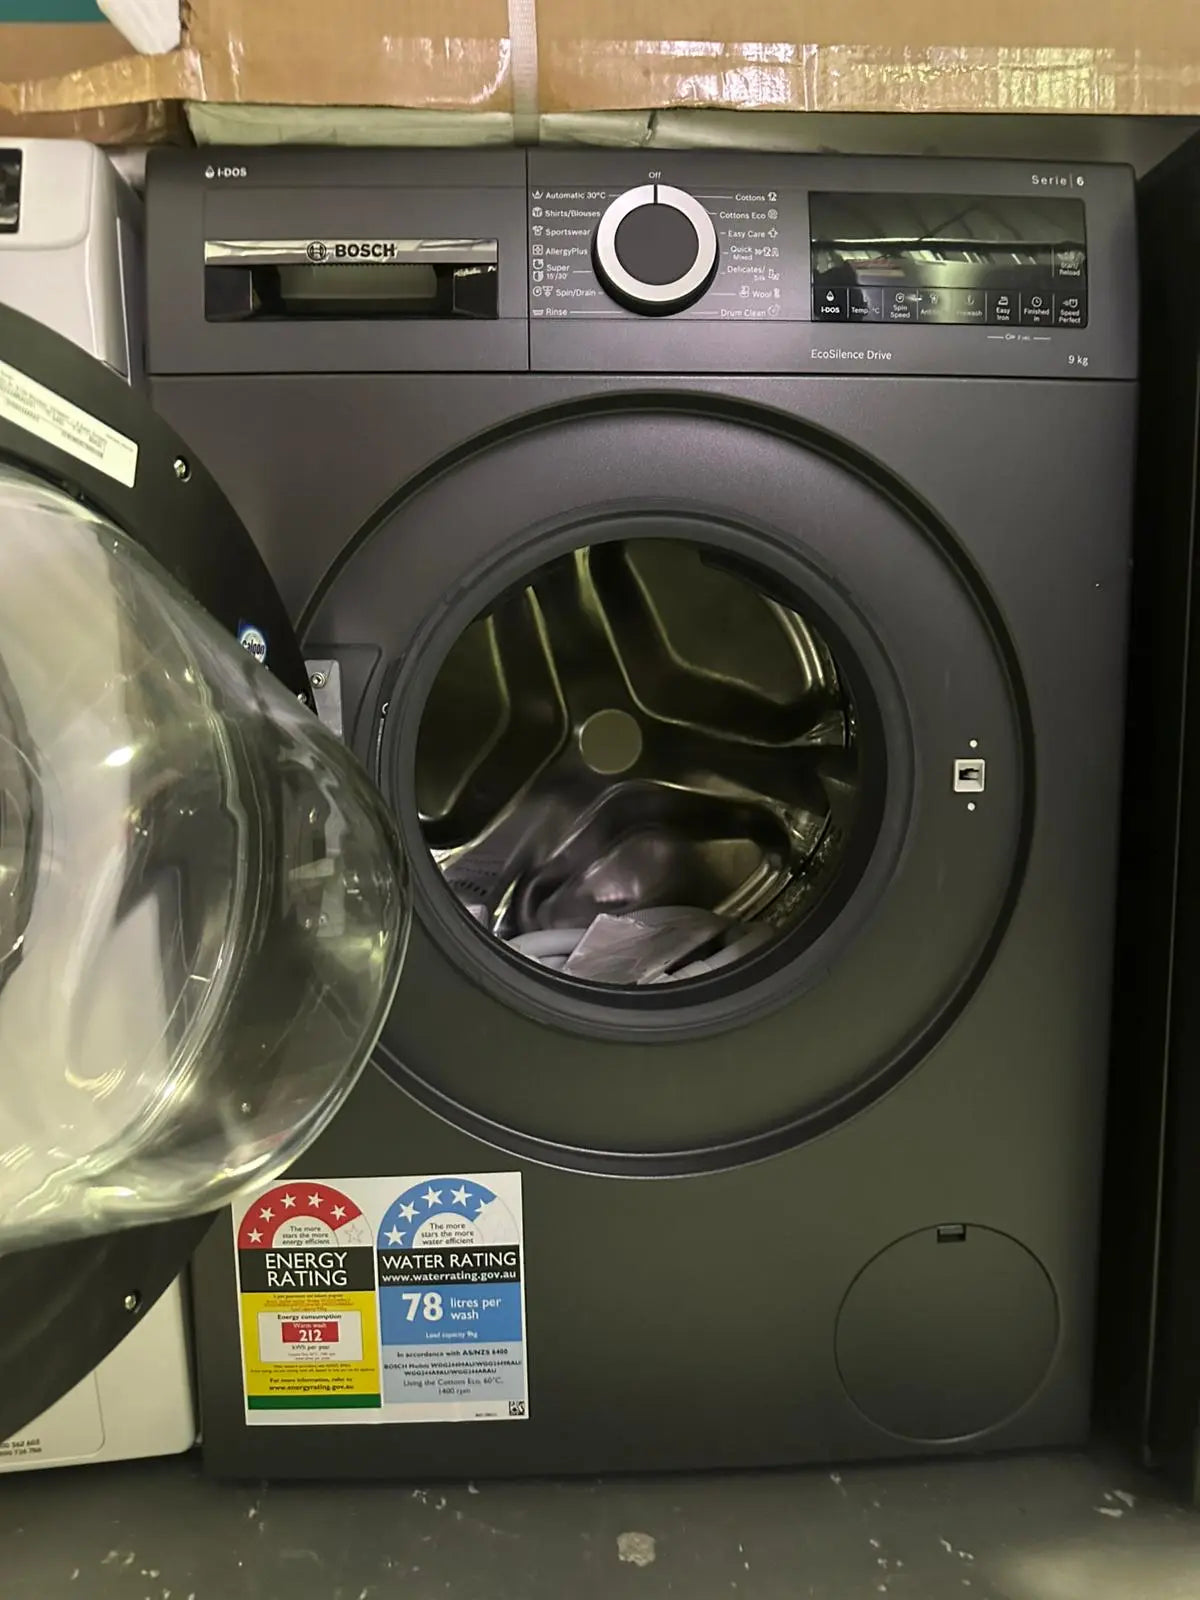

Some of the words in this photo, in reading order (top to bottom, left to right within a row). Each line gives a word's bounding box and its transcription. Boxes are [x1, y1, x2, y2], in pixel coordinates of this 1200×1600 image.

[648, 171, 661, 179] Off
[1031, 174, 1067, 186] Serie
[1076, 176, 1084, 186] 6
[545, 191, 585, 199] Automatic
[735, 193, 765, 201] Cottons
[544, 209, 601, 218] Shirts/Blouses
[719, 211, 750, 220] Cottons
[751, 212, 766, 220] Eco
[545, 228, 591, 237] Sportswear
[728, 229, 745, 239] Easy
[747, 230, 765, 238] Care
[335, 243, 396, 258] BOSCH
[545, 247, 588, 257] AllergyPlus
[730, 245, 752, 253] Quick
[546, 264, 570, 272] Super
[555, 288, 596, 297] Spin/Drain
[752, 290, 772, 298] Wool
[546, 308, 568, 316] Rinse
[892, 304, 908, 312] Spin
[996, 307, 1011, 315] Easy
[1023, 308, 1050, 316] Finished
[720, 309, 743, 317] Drum
[744, 309, 766, 317] Clean
[890, 311, 911, 319] Speed
[1060, 309, 1080, 317] Speed
[1058, 316, 1081, 324] Perfect
[811, 349, 865, 360] EcoSilence
[867, 350, 892, 360] Drive
[1068, 354, 1075, 364] 9
[1077, 354, 1089, 367] kg
[430, 1222, 444, 1230] The
[265, 1251, 347, 1269] ENERGY
[382, 1254, 445, 1269] WATER
[450, 1251, 517, 1268] RATING
[267, 1270, 347, 1287] RATING
[382, 1270, 517, 1282] www.waterrating.gov.au
[401, 1291, 444, 1321] 78
[450, 1297, 479, 1308] litres
[482, 1298, 502, 1310] per
[450, 1310, 479, 1320] wash
[299, 1329, 323, 1342] 212
[269, 1383, 354, 1392] www.energyrating.gov.au
